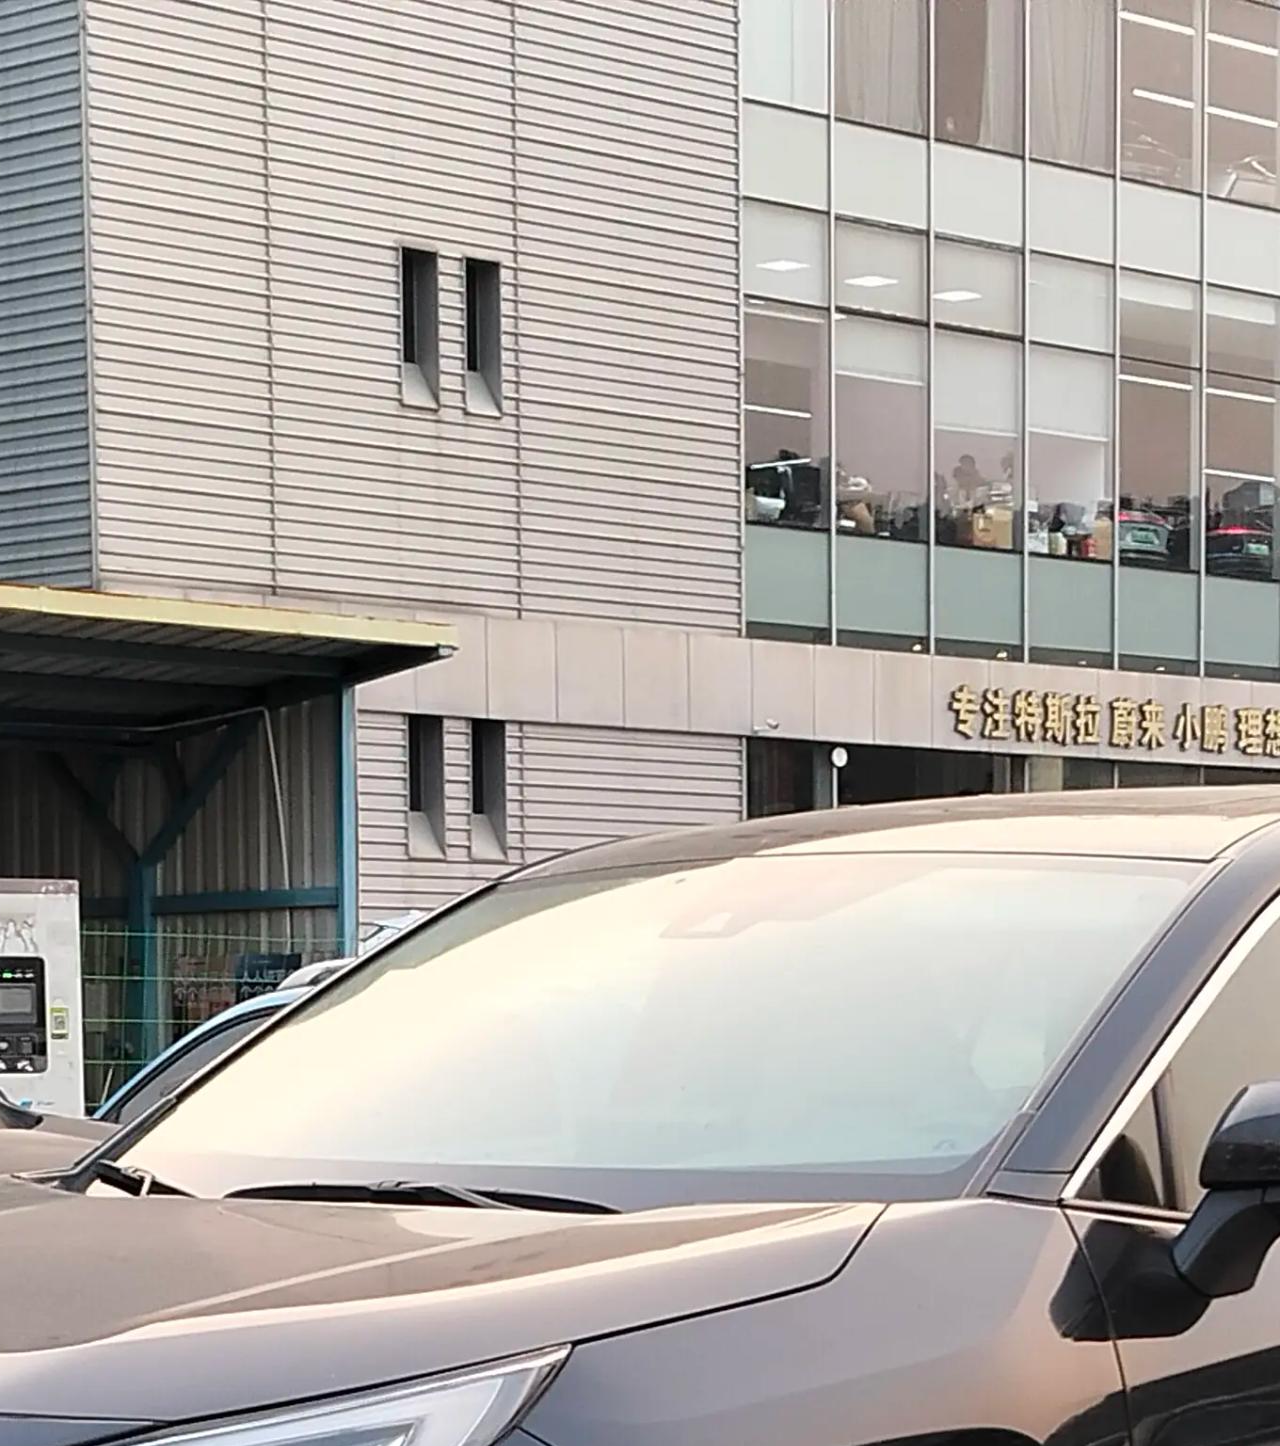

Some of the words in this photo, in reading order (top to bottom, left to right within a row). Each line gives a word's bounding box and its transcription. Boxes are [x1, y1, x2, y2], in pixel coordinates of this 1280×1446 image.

[950, 684, 1101, 745] 专注特斯拉
[1110, 697, 1166, 749] 蔚来
[1174, 702, 1230, 754] 小鹏
